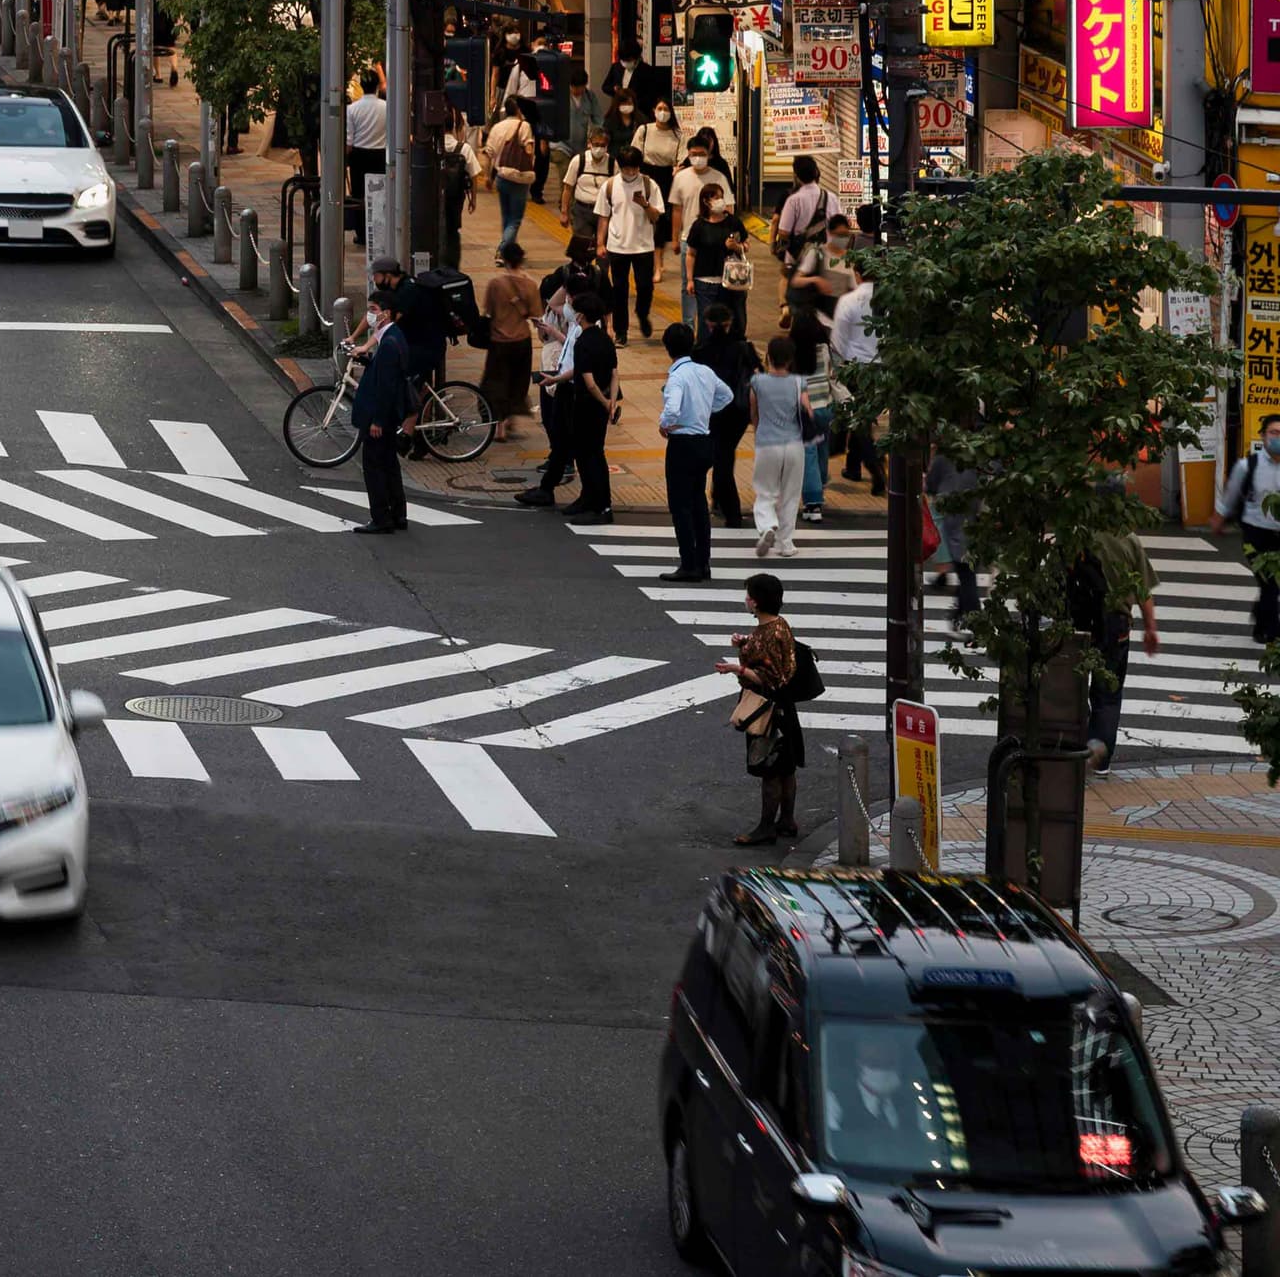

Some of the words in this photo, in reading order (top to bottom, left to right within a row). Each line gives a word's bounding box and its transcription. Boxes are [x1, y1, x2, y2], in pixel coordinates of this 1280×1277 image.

[794, 8, 860, 24] 記念切手
[1248, 240, 1280, 268] 外
[1248, 268, 1280, 295] 送
